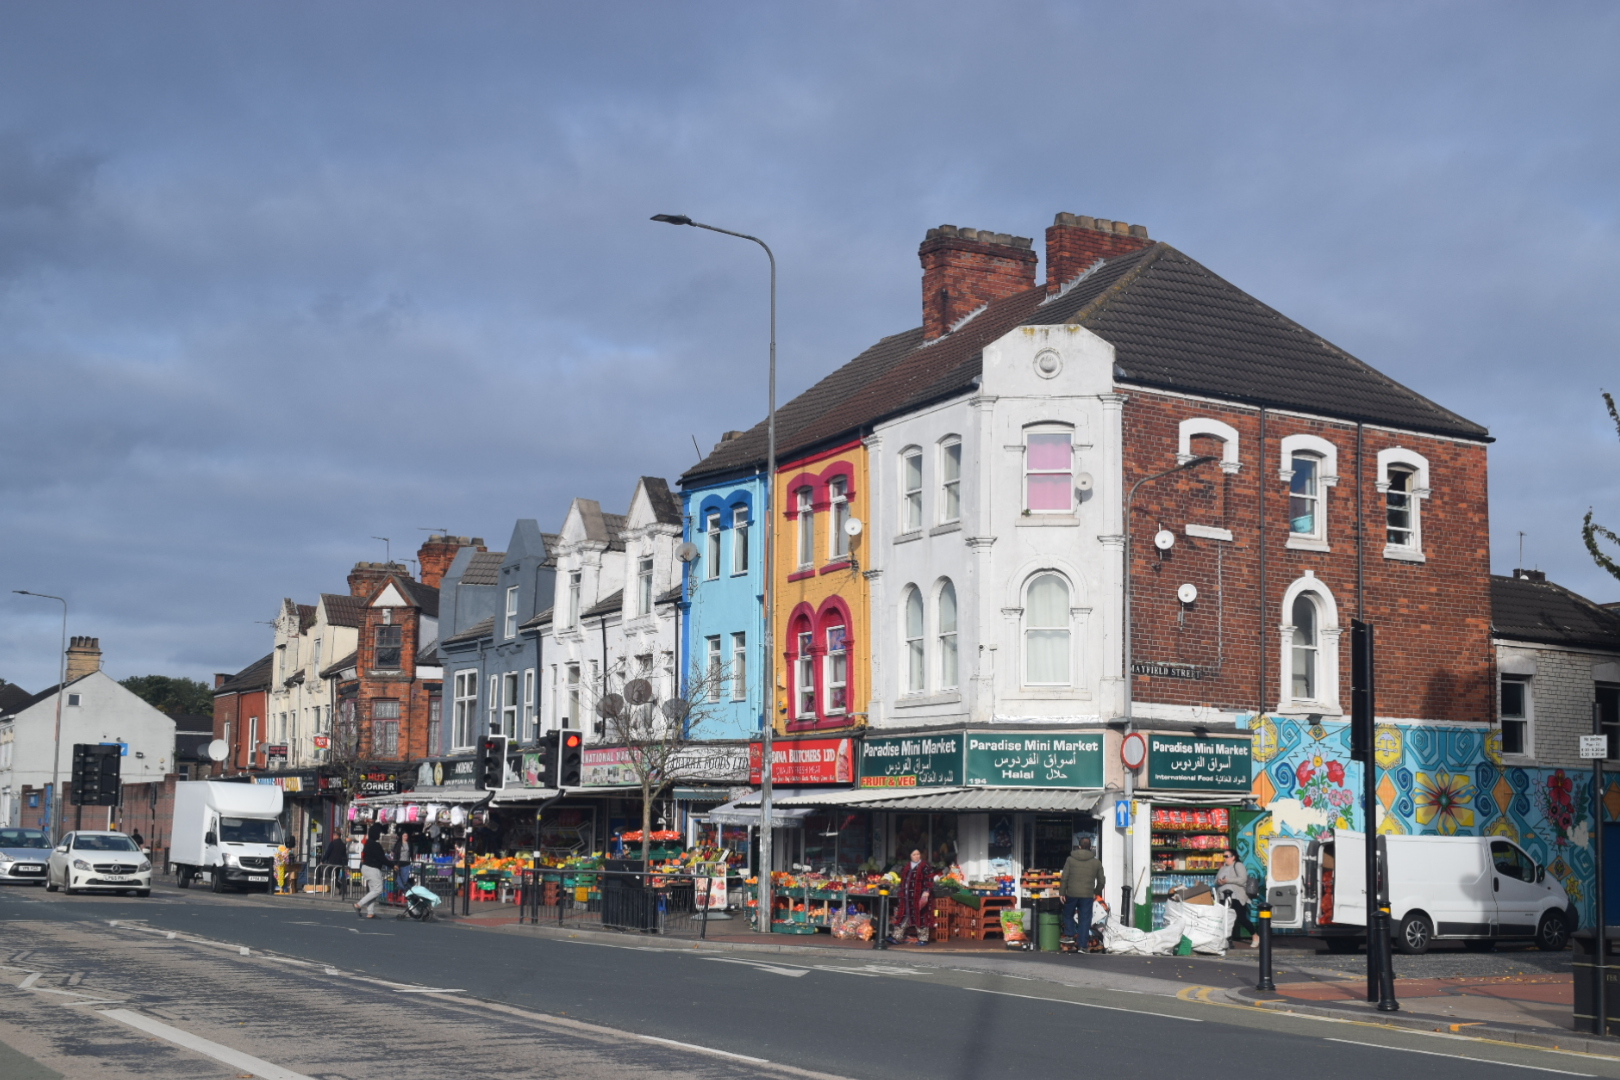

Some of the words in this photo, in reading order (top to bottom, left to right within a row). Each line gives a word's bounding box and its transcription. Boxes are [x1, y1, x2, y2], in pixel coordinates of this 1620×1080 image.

[1171, 668, 1201, 679] STREET
[863, 741, 900, 757] Paradise
[901, 740, 921, 756] Mini
[922, 738, 956, 755] Market
[969, 739, 1021, 751] Paradise
[1024, 739, 1051, 751] Mini
[1053, 740, 1099, 752] Market
[1153, 741, 1193, 753] Paradise
[1194, 743, 1214, 754] Mini
[1215, 744, 1248, 756] Market
[788, 749, 821, 762] BUTCHERS
[823, 748, 836, 761] LTD
[994, 752, 1039, 768] الفردوس
[1044, 752, 1076, 769] أسواق
[703, 756, 730, 769] FOODS
[732, 756, 749, 769] LTD
[885, 757, 912, 775] الفردوس
[913, 755, 932, 774] أسواق
[1171, 756, 1205, 771] الفردوس
[1207, 756, 1231, 772] أسواق
[861, 776, 886, 786] FRUIT
[888, 776, 896, 786] &
[898, 776, 916, 786] VEG
[1002, 769, 1034, 779] Halal
[1046, 768, 1068, 780] حلال
[361, 782, 394, 791] CORNER
